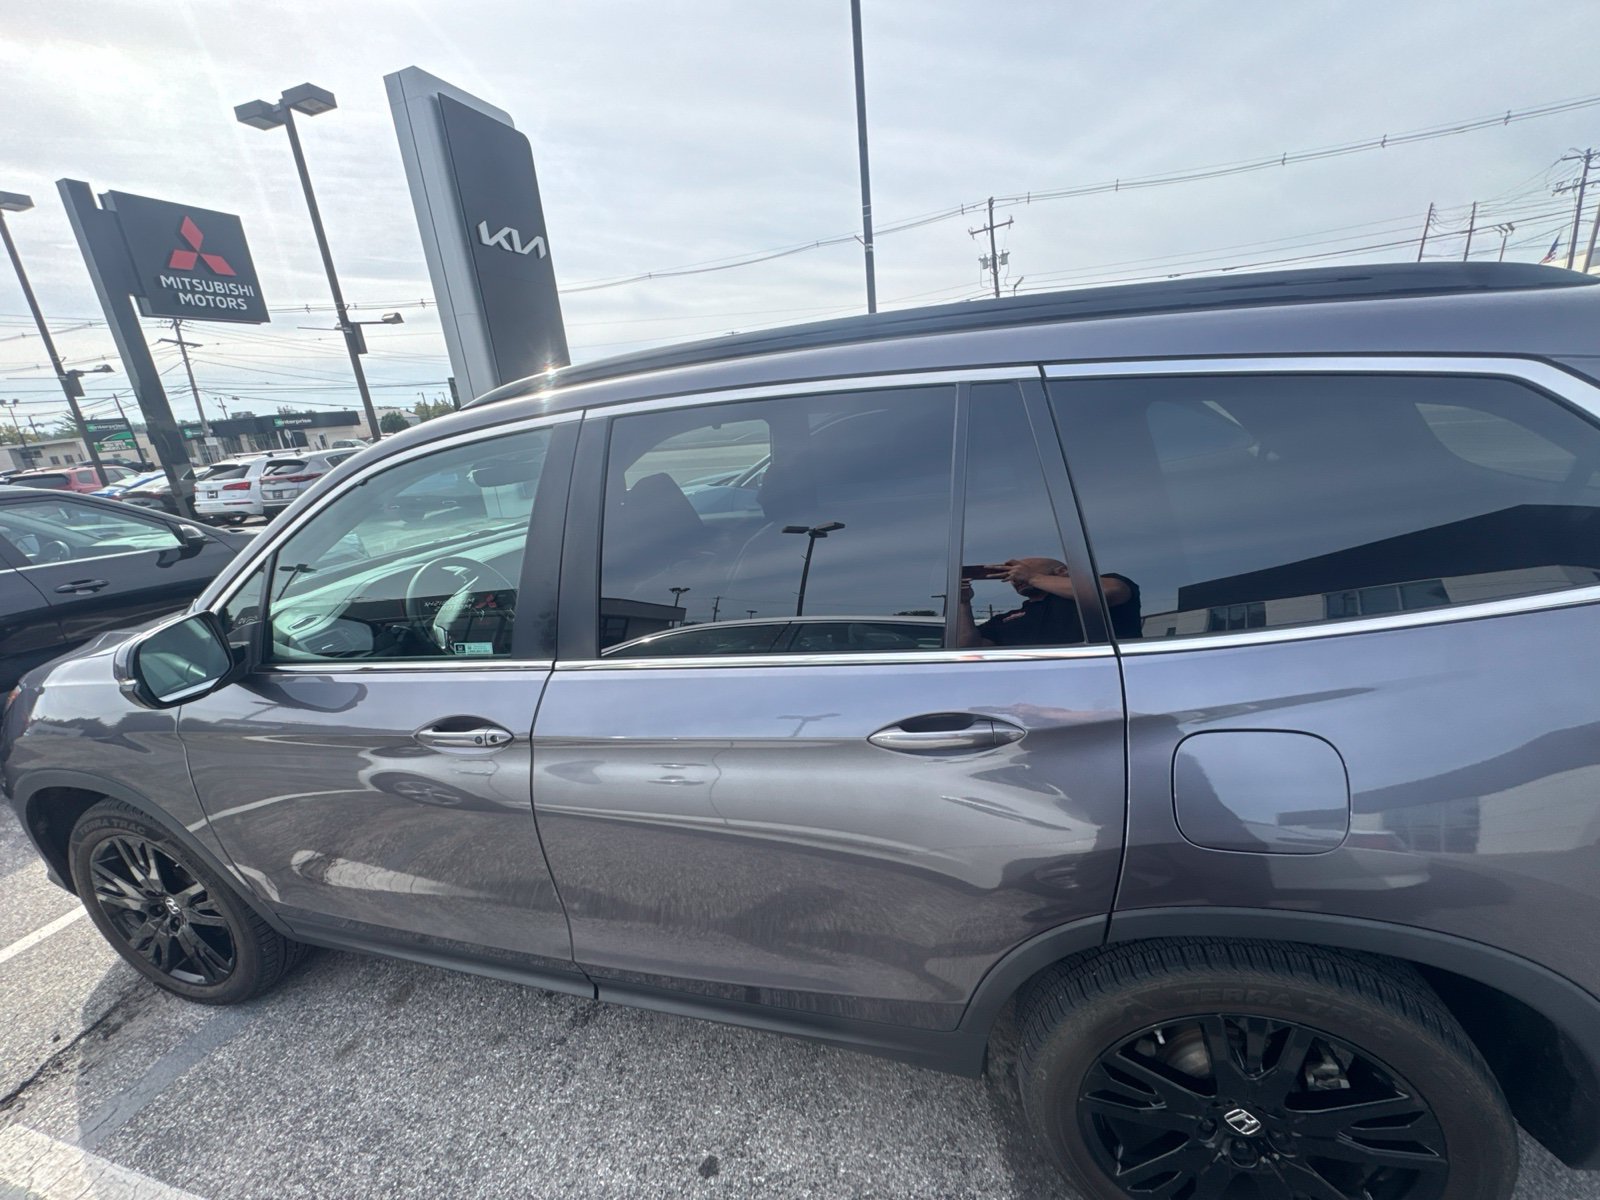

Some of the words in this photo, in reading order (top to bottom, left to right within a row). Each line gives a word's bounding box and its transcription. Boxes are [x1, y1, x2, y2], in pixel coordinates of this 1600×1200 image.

[477, 220, 547, 259] KIA
[160, 274, 255, 297] MITSUBISHI
[178, 292, 248, 310] MOTORS
[112, 818, 145, 834] TRAC
[1175, 986, 1293, 1008] TERRA
